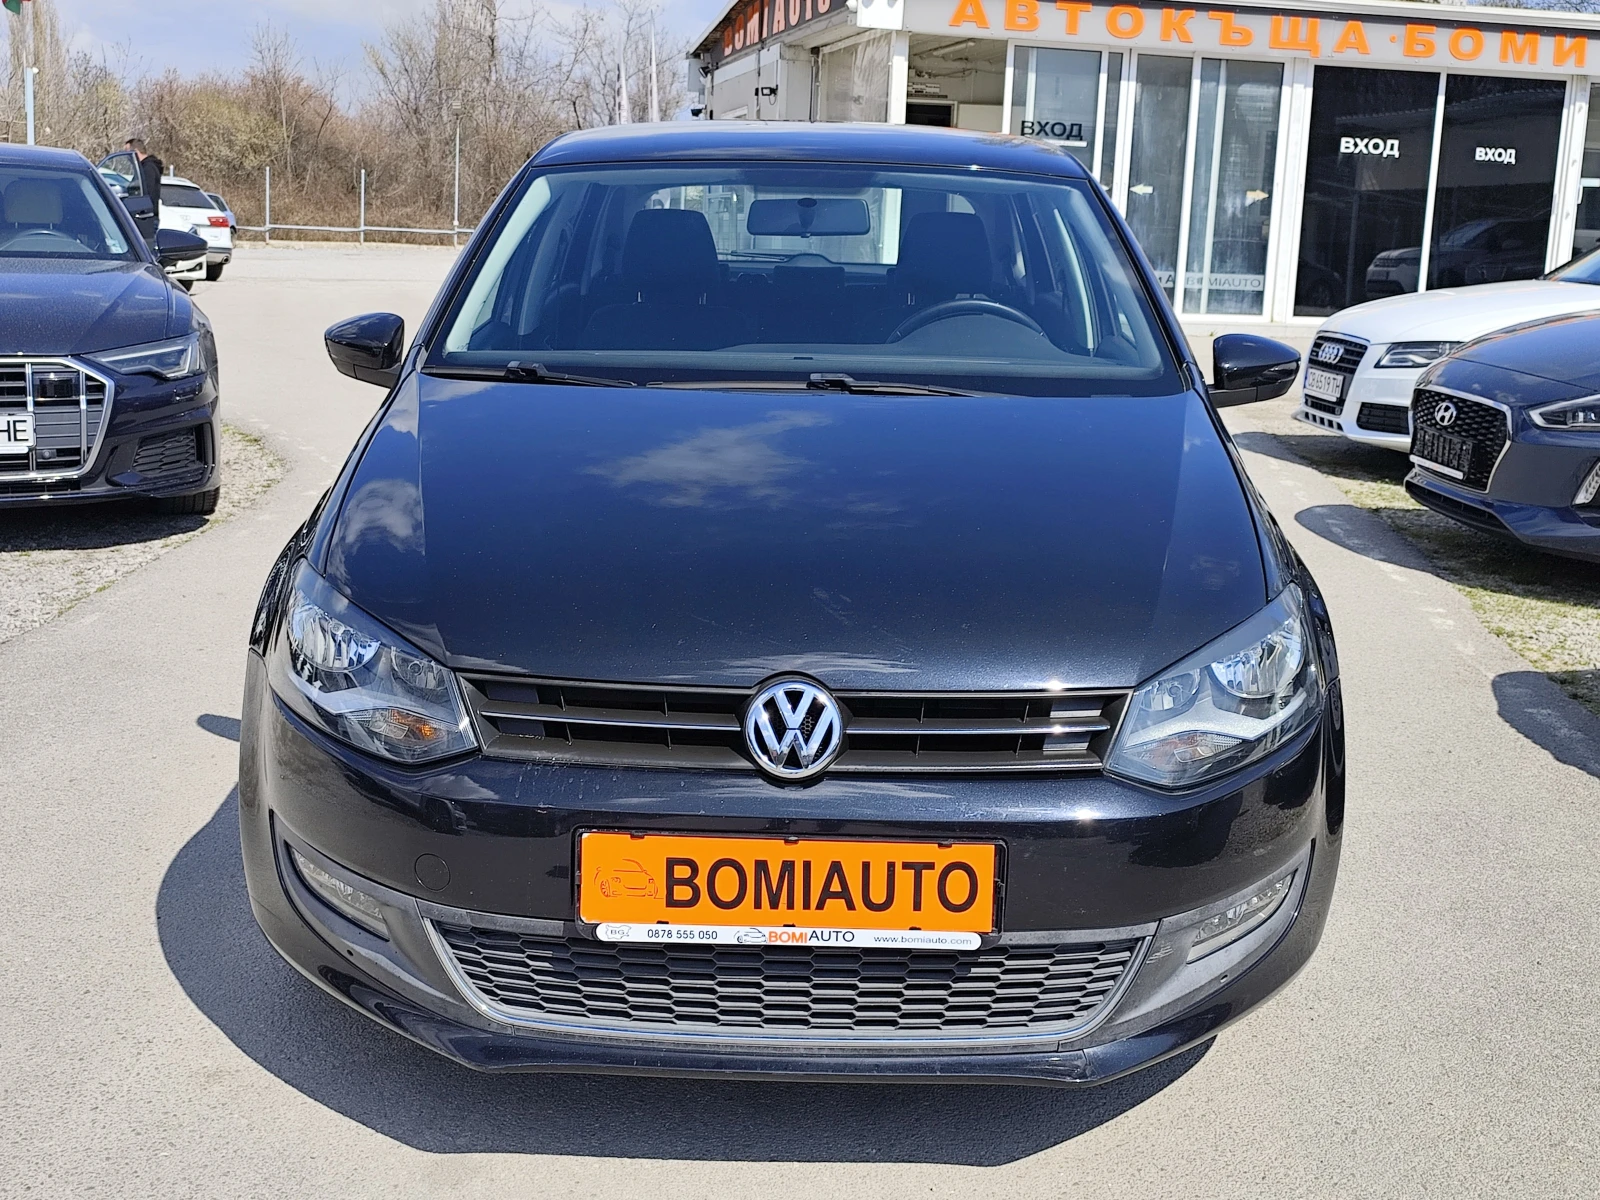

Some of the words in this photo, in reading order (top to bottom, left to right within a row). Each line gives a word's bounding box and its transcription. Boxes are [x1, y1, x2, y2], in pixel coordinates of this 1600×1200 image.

[724, 0, 831, 57] BOMIAU
[949, 0, 1371, 58] АВТОКЪЩА
[1403, 23, 1588, 67] БОМИ
[1020, 120, 1083, 141] ВХОД
[1340, 136, 1400, 159] ВХОД
[1474, 146, 1517, 165] ВХОД
[664, 856, 979, 913] BOMIAUTO
[647, 929, 673, 939] 0878
[676, 930, 695, 940] 555
[698, 930, 718, 940] 050
[873, 935, 972, 945] www.bomiauto.com
